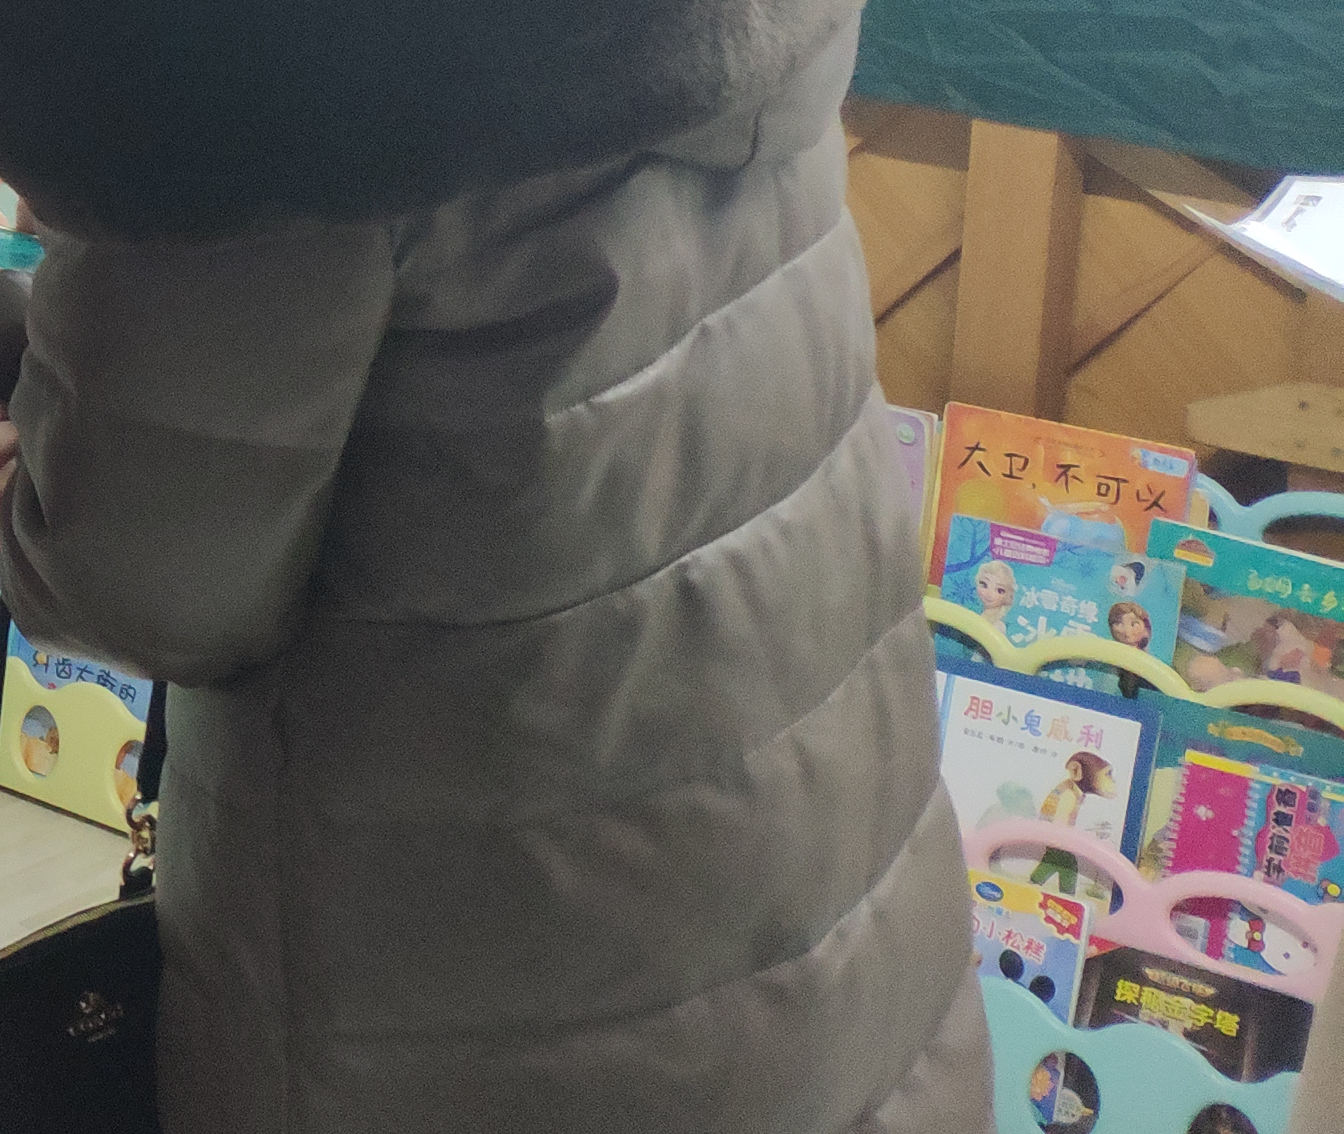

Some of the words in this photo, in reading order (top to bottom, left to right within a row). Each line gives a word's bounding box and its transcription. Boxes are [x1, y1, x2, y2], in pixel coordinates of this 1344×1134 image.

[963, 695, 1107, 751] 胆小鬼威利
[1114, 978, 1241, 1038] 探秘金字塔
